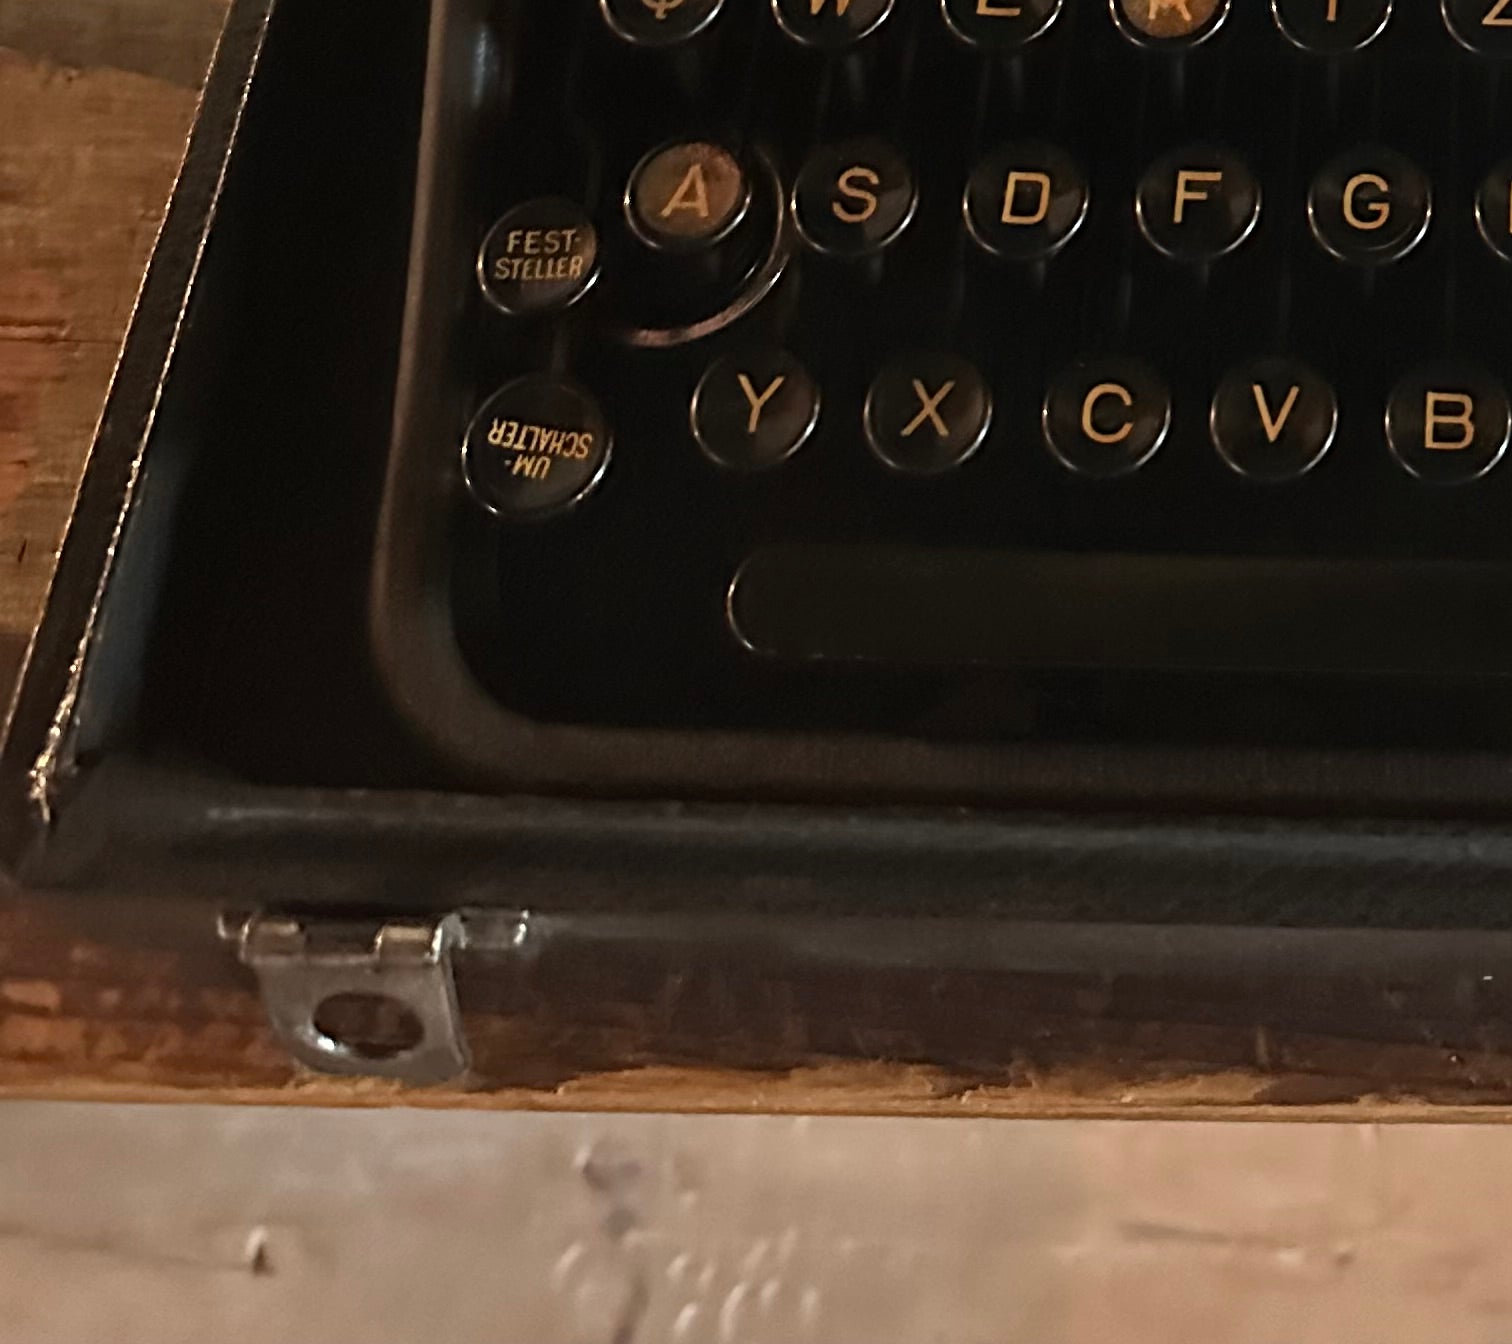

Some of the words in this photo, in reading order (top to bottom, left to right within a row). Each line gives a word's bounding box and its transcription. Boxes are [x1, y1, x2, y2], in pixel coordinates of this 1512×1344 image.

[662, 164, 708, 217] A
[833, 168, 879, 221] S
[1002, 172, 1050, 224] D
[1174, 171, 1221, 222] F
[1344, 174, 1389, 229] G
[494, 255, 583, 280] STELLER
[739, 375, 783, 432] Y
[902, 381, 953, 436] X
[1082, 384, 1132, 442] C
[1253, 385, 1298, 441] V
[1425, 392, 1474, 449] B
[487, 417, 593, 459] SCHALTER
